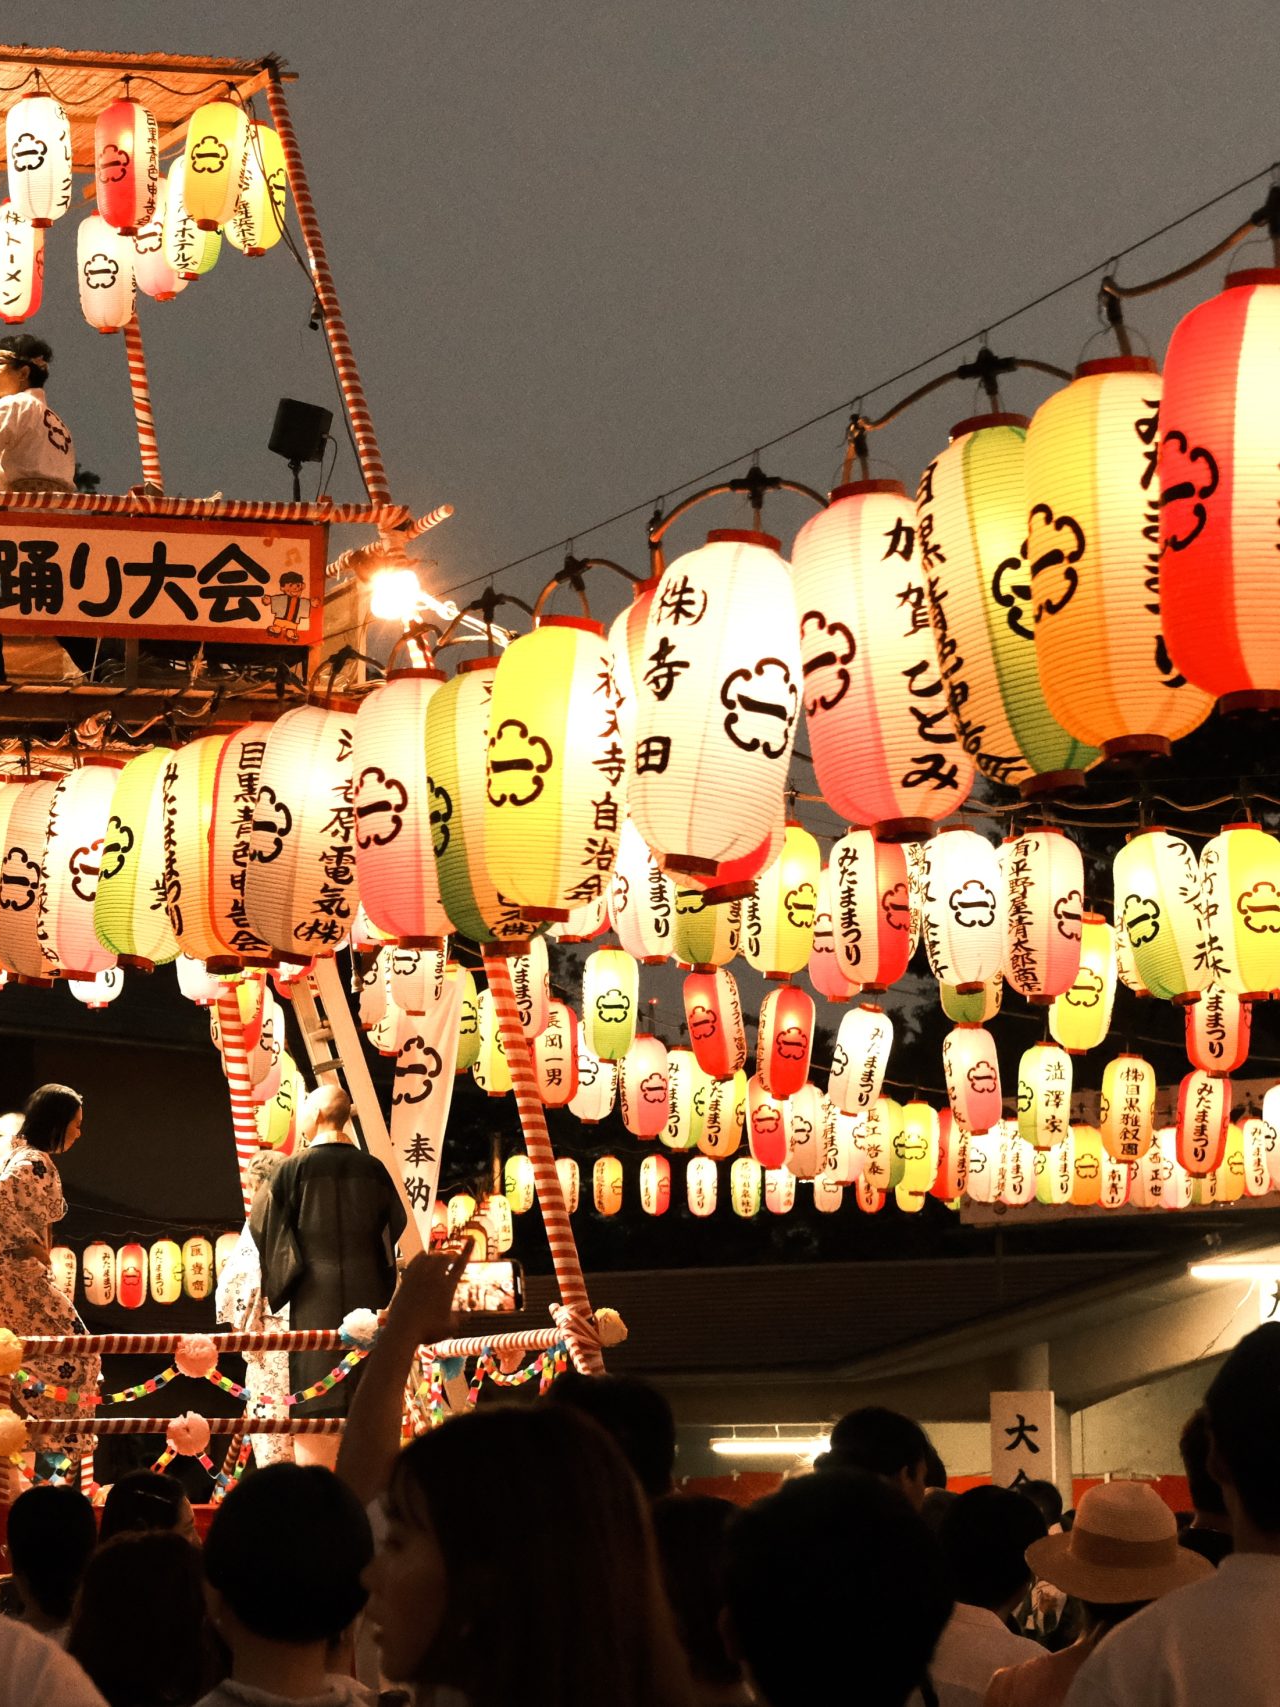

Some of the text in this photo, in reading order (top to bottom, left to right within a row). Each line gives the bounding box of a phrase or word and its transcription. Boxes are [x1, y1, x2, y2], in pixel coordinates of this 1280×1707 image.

[226, 741, 271, 953] 目黒青色申告会
[647, 855, 671, 938] ままつり
[837, 846, 862, 967] みたままつり
[544, 1010, 564, 1088] 長岡一男
[667, 1062, 681, 1138] みたままつり
[1192, 1081, 1214, 1162] みたままつり
[403, 1131, 436, 1213] 奉納
[1149, 1134, 1162, 1197] 大西正也
[1251, 1126, 1265, 1187] みたままつり
[1003, 1413, 1041, 1489] 大
